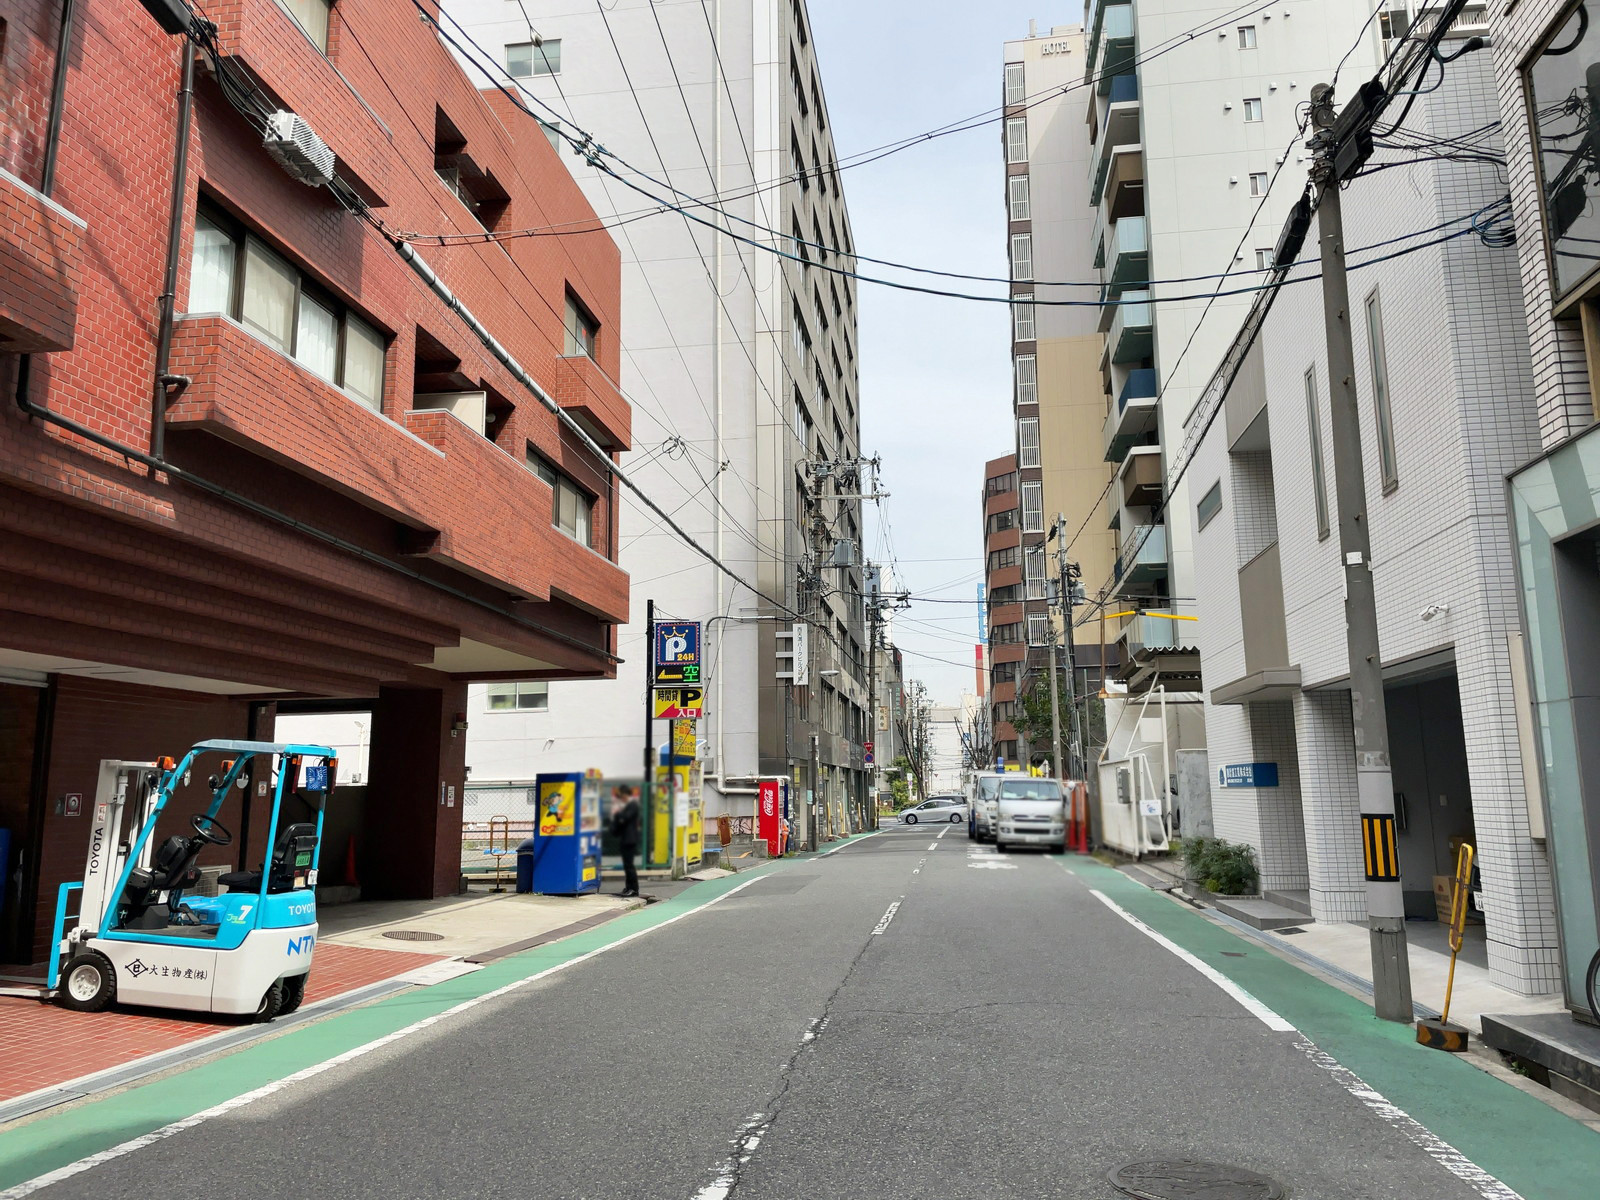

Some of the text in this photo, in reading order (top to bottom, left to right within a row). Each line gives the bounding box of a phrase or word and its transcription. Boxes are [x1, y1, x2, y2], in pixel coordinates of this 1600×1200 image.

[1042, 41, 1071, 55] HOTEL
[666, 636, 687, 661] P
[677, 653, 694, 661] 24H
[683, 665, 699, 682] 空
[680, 690, 701, 707] P
[677, 708, 697, 718] 入口
[89, 827, 104, 876] TOYOTA
[288, 902, 316, 916] TOYOT
